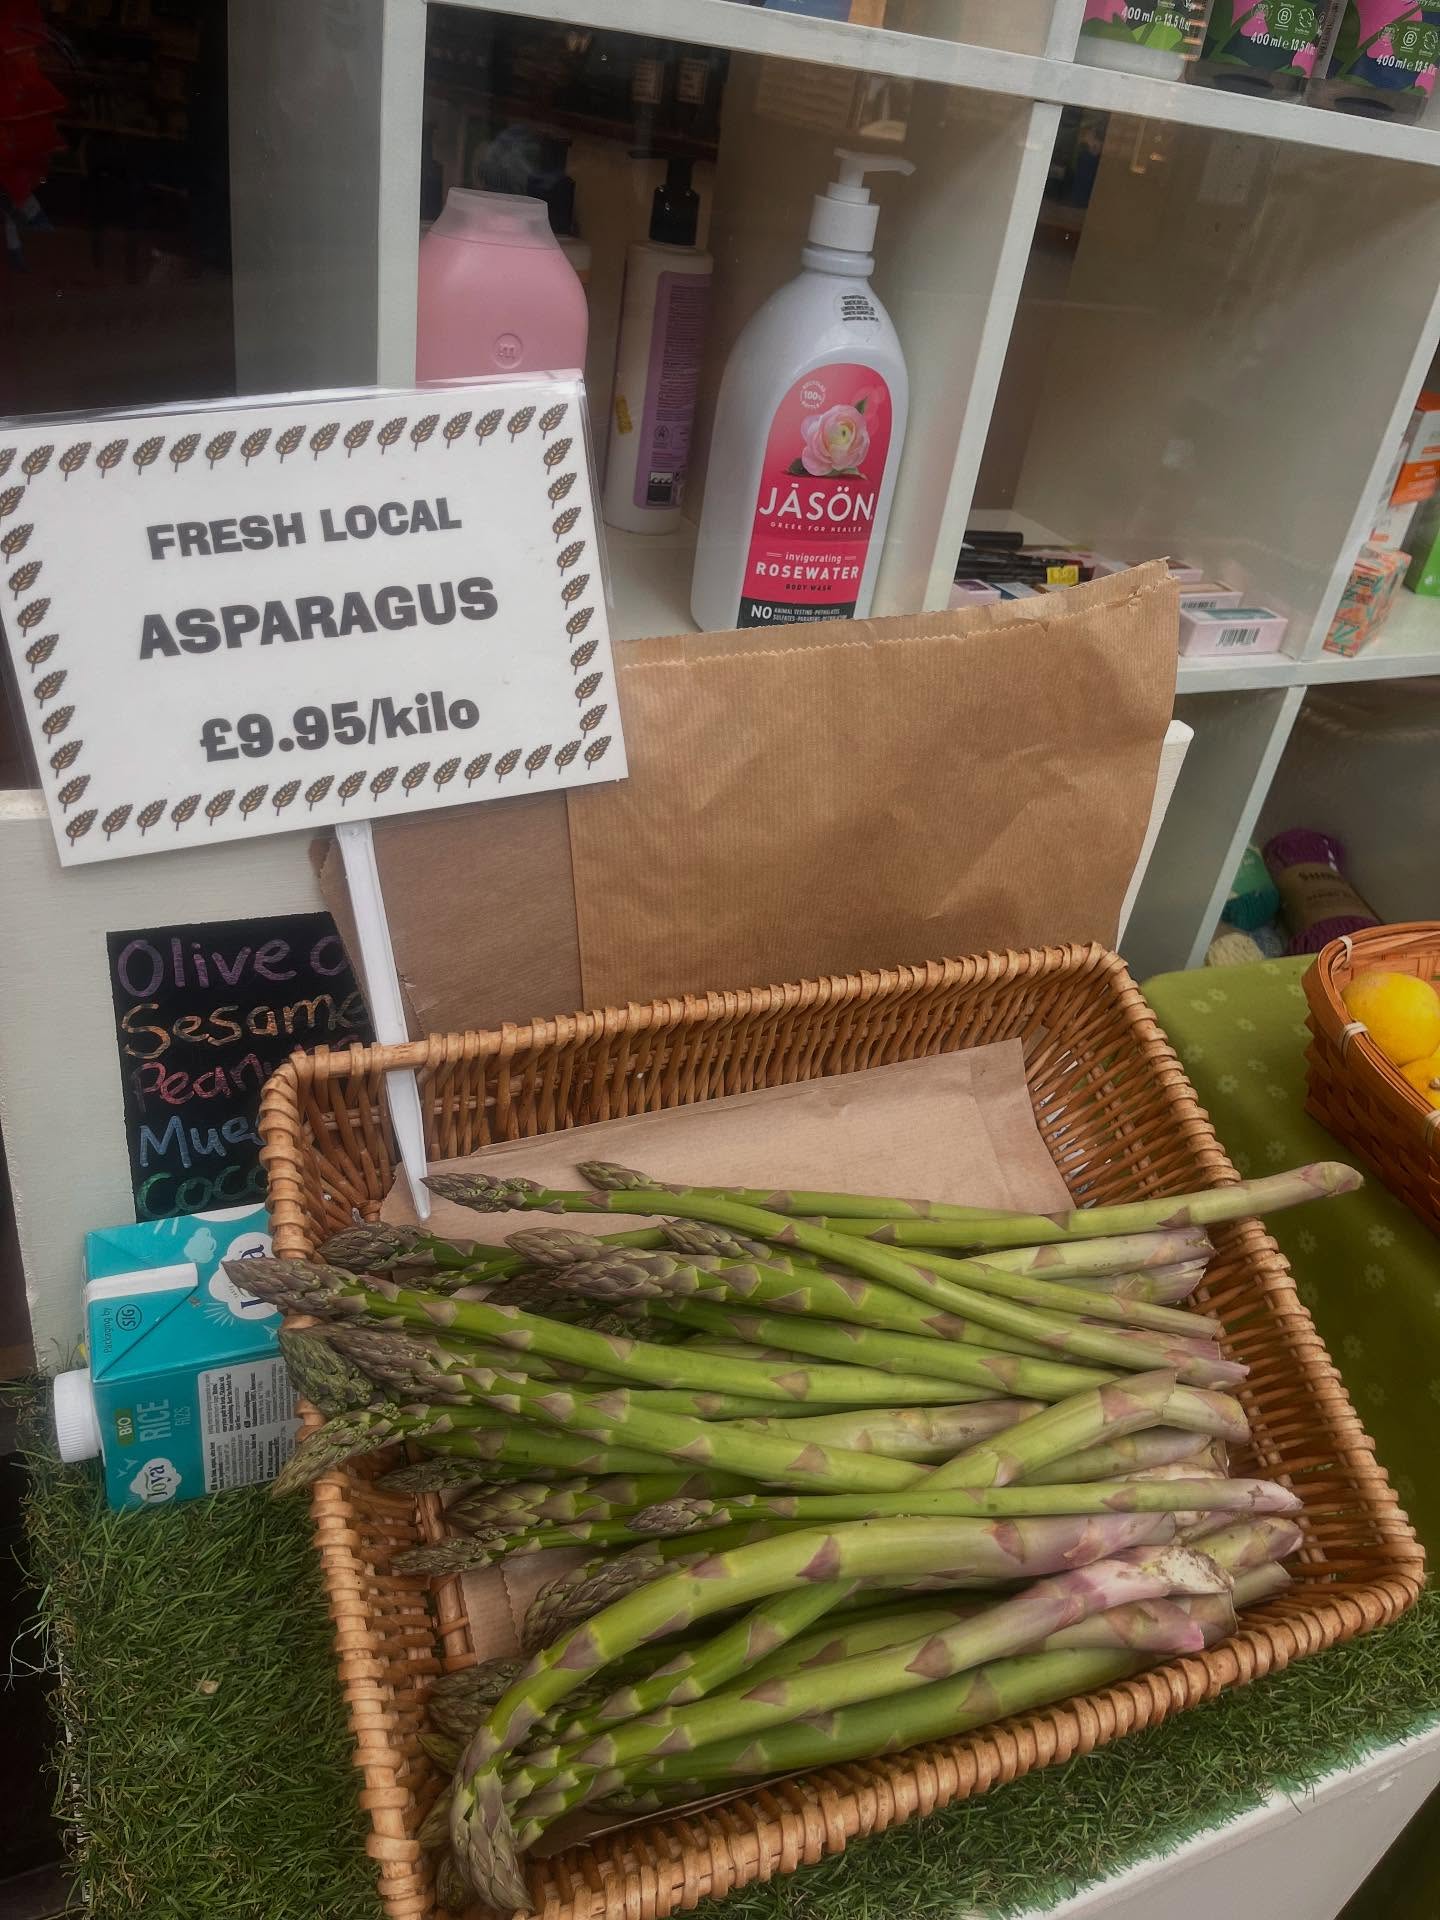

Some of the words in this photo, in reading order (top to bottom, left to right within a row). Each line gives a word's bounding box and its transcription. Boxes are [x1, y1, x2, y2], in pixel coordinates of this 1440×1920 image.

[1121, 7, 1141, 21] 400
[1251, 32, 1270, 45] 400
[1270, 36, 1282, 47] ml
[1376, 54, 1395, 67] 400
[1395, 58, 1407, 69] ml
[146, 512, 306, 560] FRESH
[320, 497, 462, 542] LOCAL
[770, 521, 802, 530] GREEK
[785, 552, 842, 564] invigorating
[756, 561, 860, 580] ROSEWATER
[785, 583, 807, 591] BODY
[139, 576, 499, 660] ASPARAGUS
[751, 604, 773, 619] NO
[200, 690, 481, 763] £9.95/kilo
[118, 937, 297, 998] Olive
[121, 1308, 137, 1327] SIG
[136, 1398, 173, 1442] RICE
[147, 1465, 172, 1497] Joya
